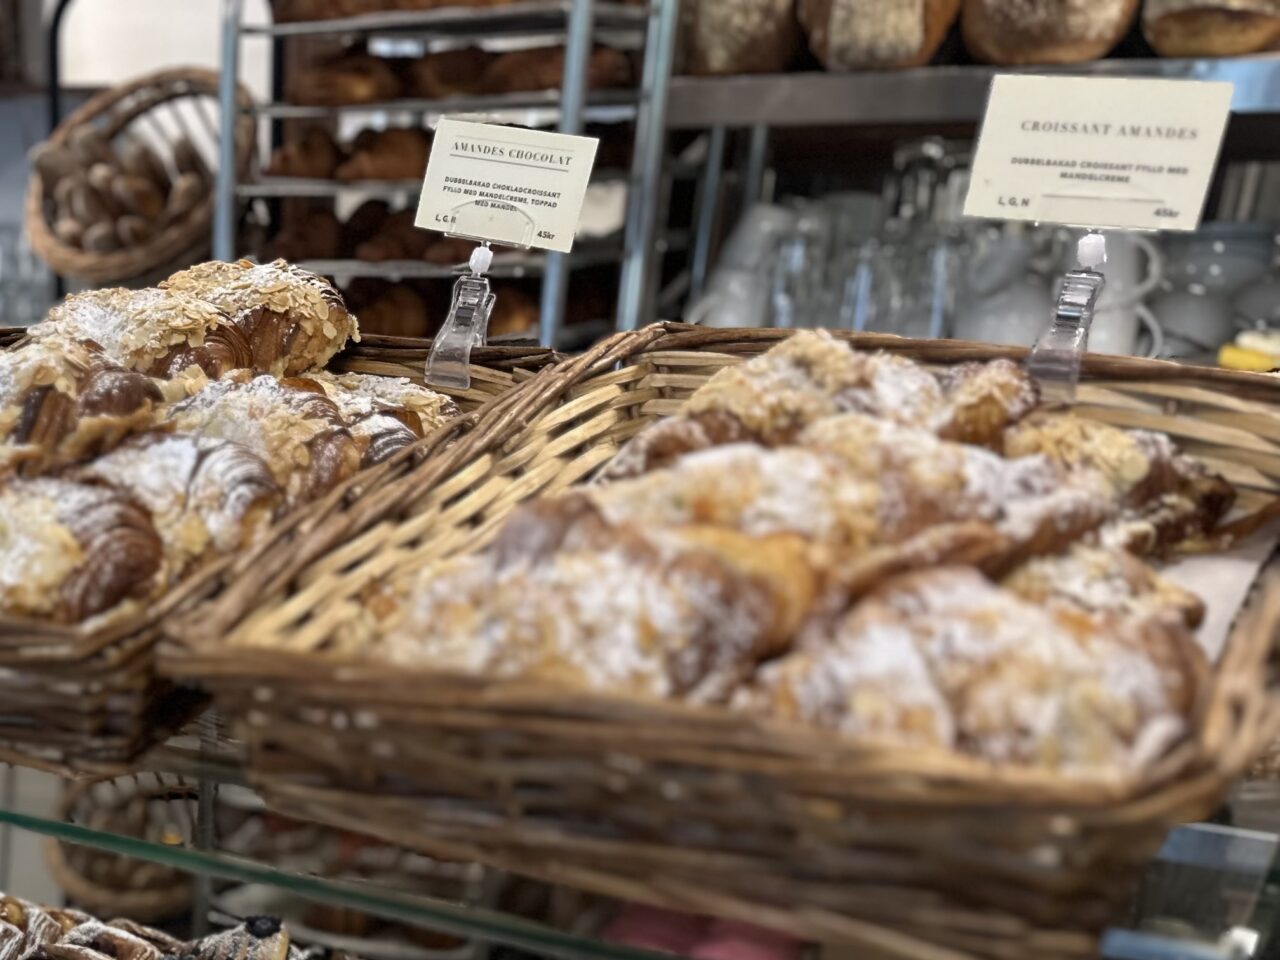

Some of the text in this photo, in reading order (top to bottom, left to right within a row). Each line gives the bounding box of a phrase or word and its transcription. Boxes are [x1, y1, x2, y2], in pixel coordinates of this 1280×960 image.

[1020, 120, 1199, 140] CROISSANT AMANDES
[453, 142, 572, 166] AMANDES CHOCOLAT
[1011, 157, 1078, 167] DUBBELBAKAD
[1079, 161, 1133, 171] CROISSANT
[1135, 165, 1165, 173] FYLLD
[445, 176, 559, 199] DUBBELBAKAD CHOKLADCROISSANT
[1060, 172, 1130, 183] MANDELCREME
[443, 185, 461, 193] FYLLD
[531, 199, 557, 208] TOPPAD
[537, 231, 554, 240] 45kr
